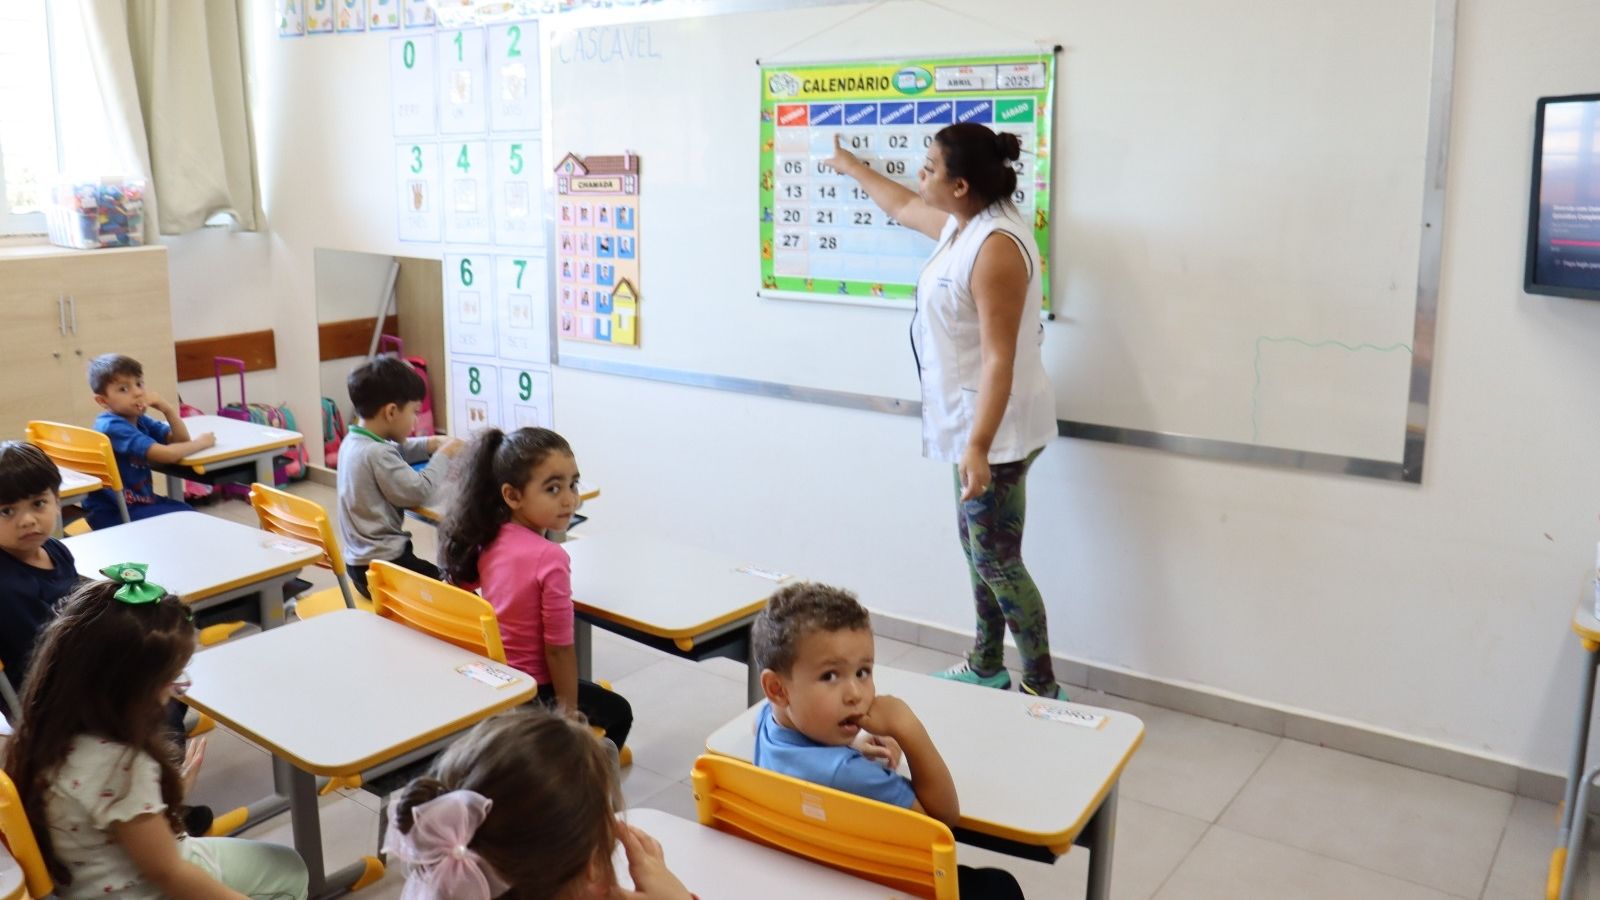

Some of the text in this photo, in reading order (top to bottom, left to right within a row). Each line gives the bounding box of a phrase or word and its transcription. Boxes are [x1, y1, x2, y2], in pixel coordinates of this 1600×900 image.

[402, 40, 416, 70] 0
[453, 32, 464, 62] 1
[508, 26, 522, 58] 2
[802, 73, 890, 93] CALENDÁRIO
[947, 77, 972, 87] ABRIL
[1004, 75, 1031, 87] 2025
[852, 136, 870, 148] 01
[889, 136, 908, 148] 02
[411, 145, 423, 174] 3
[457, 144, 471, 174] 4
[510, 144, 524, 174] 5
[784, 161, 802, 174] 06
[886, 161, 905, 174] 09
[577, 180, 613, 189] CHAMADA
[785, 186, 802, 198] 13
[818, 187, 837, 199] 14
[783, 209, 801, 222] 20
[816, 211, 833, 223] 21
[854, 212, 872, 225] 22
[783, 235, 837, 250] 27 28
[460, 258, 473, 287] 6
[512, 260, 527, 289] 7
[469, 367, 482, 396] 8
[519, 372, 533, 401] 9
